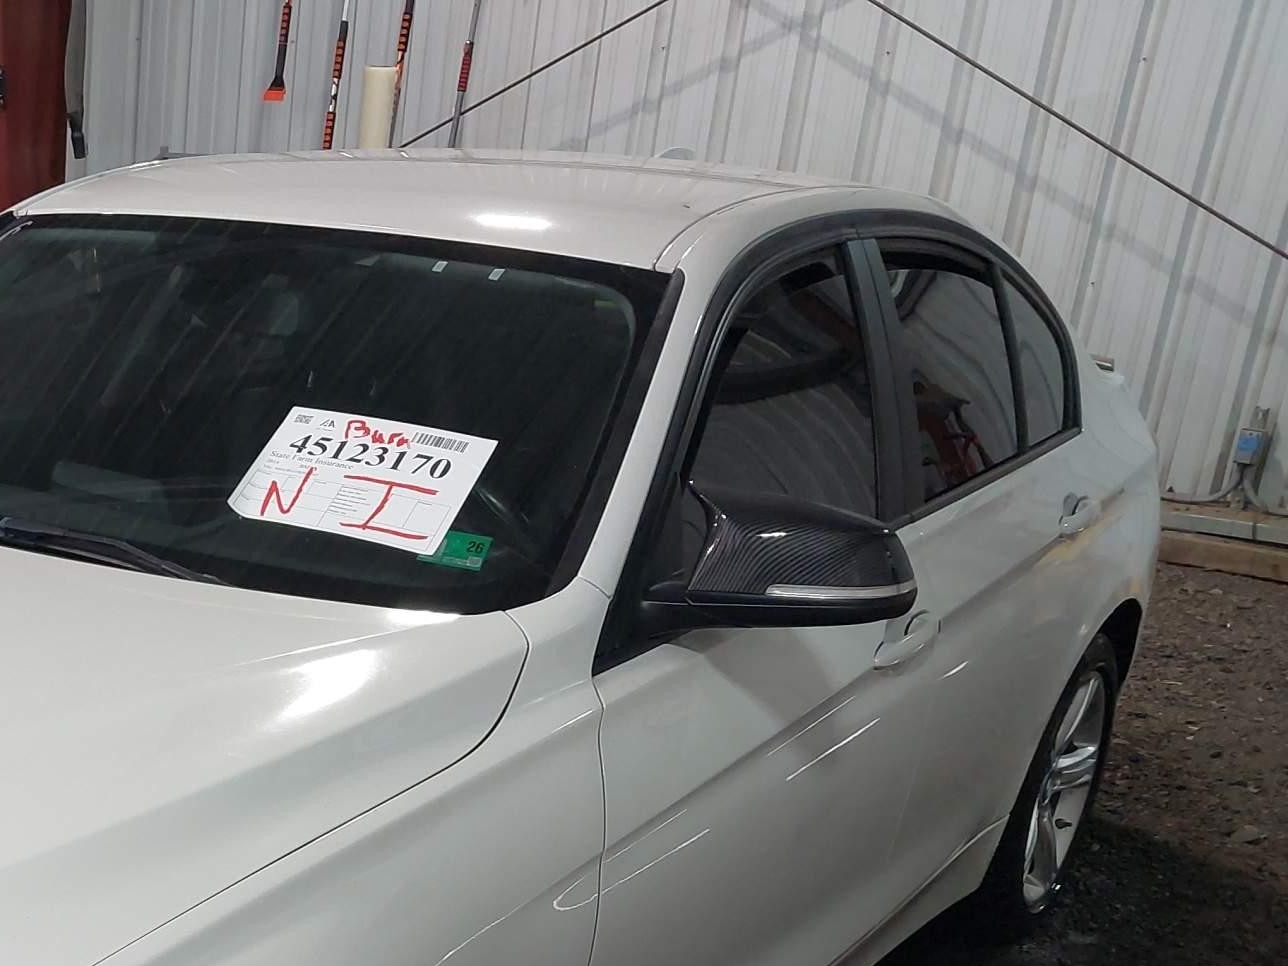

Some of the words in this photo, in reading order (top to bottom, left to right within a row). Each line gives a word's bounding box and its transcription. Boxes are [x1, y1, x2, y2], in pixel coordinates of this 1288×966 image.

[271, 450, 289, 460] State
[292, 454, 313, 463] Farm
[315, 457, 354, 470] Insurance
[289, 435, 452, 479] 45123170
[260, 466, 314, 516] N
[339, 475, 439, 540] I
[466, 541, 486, 555] 26
